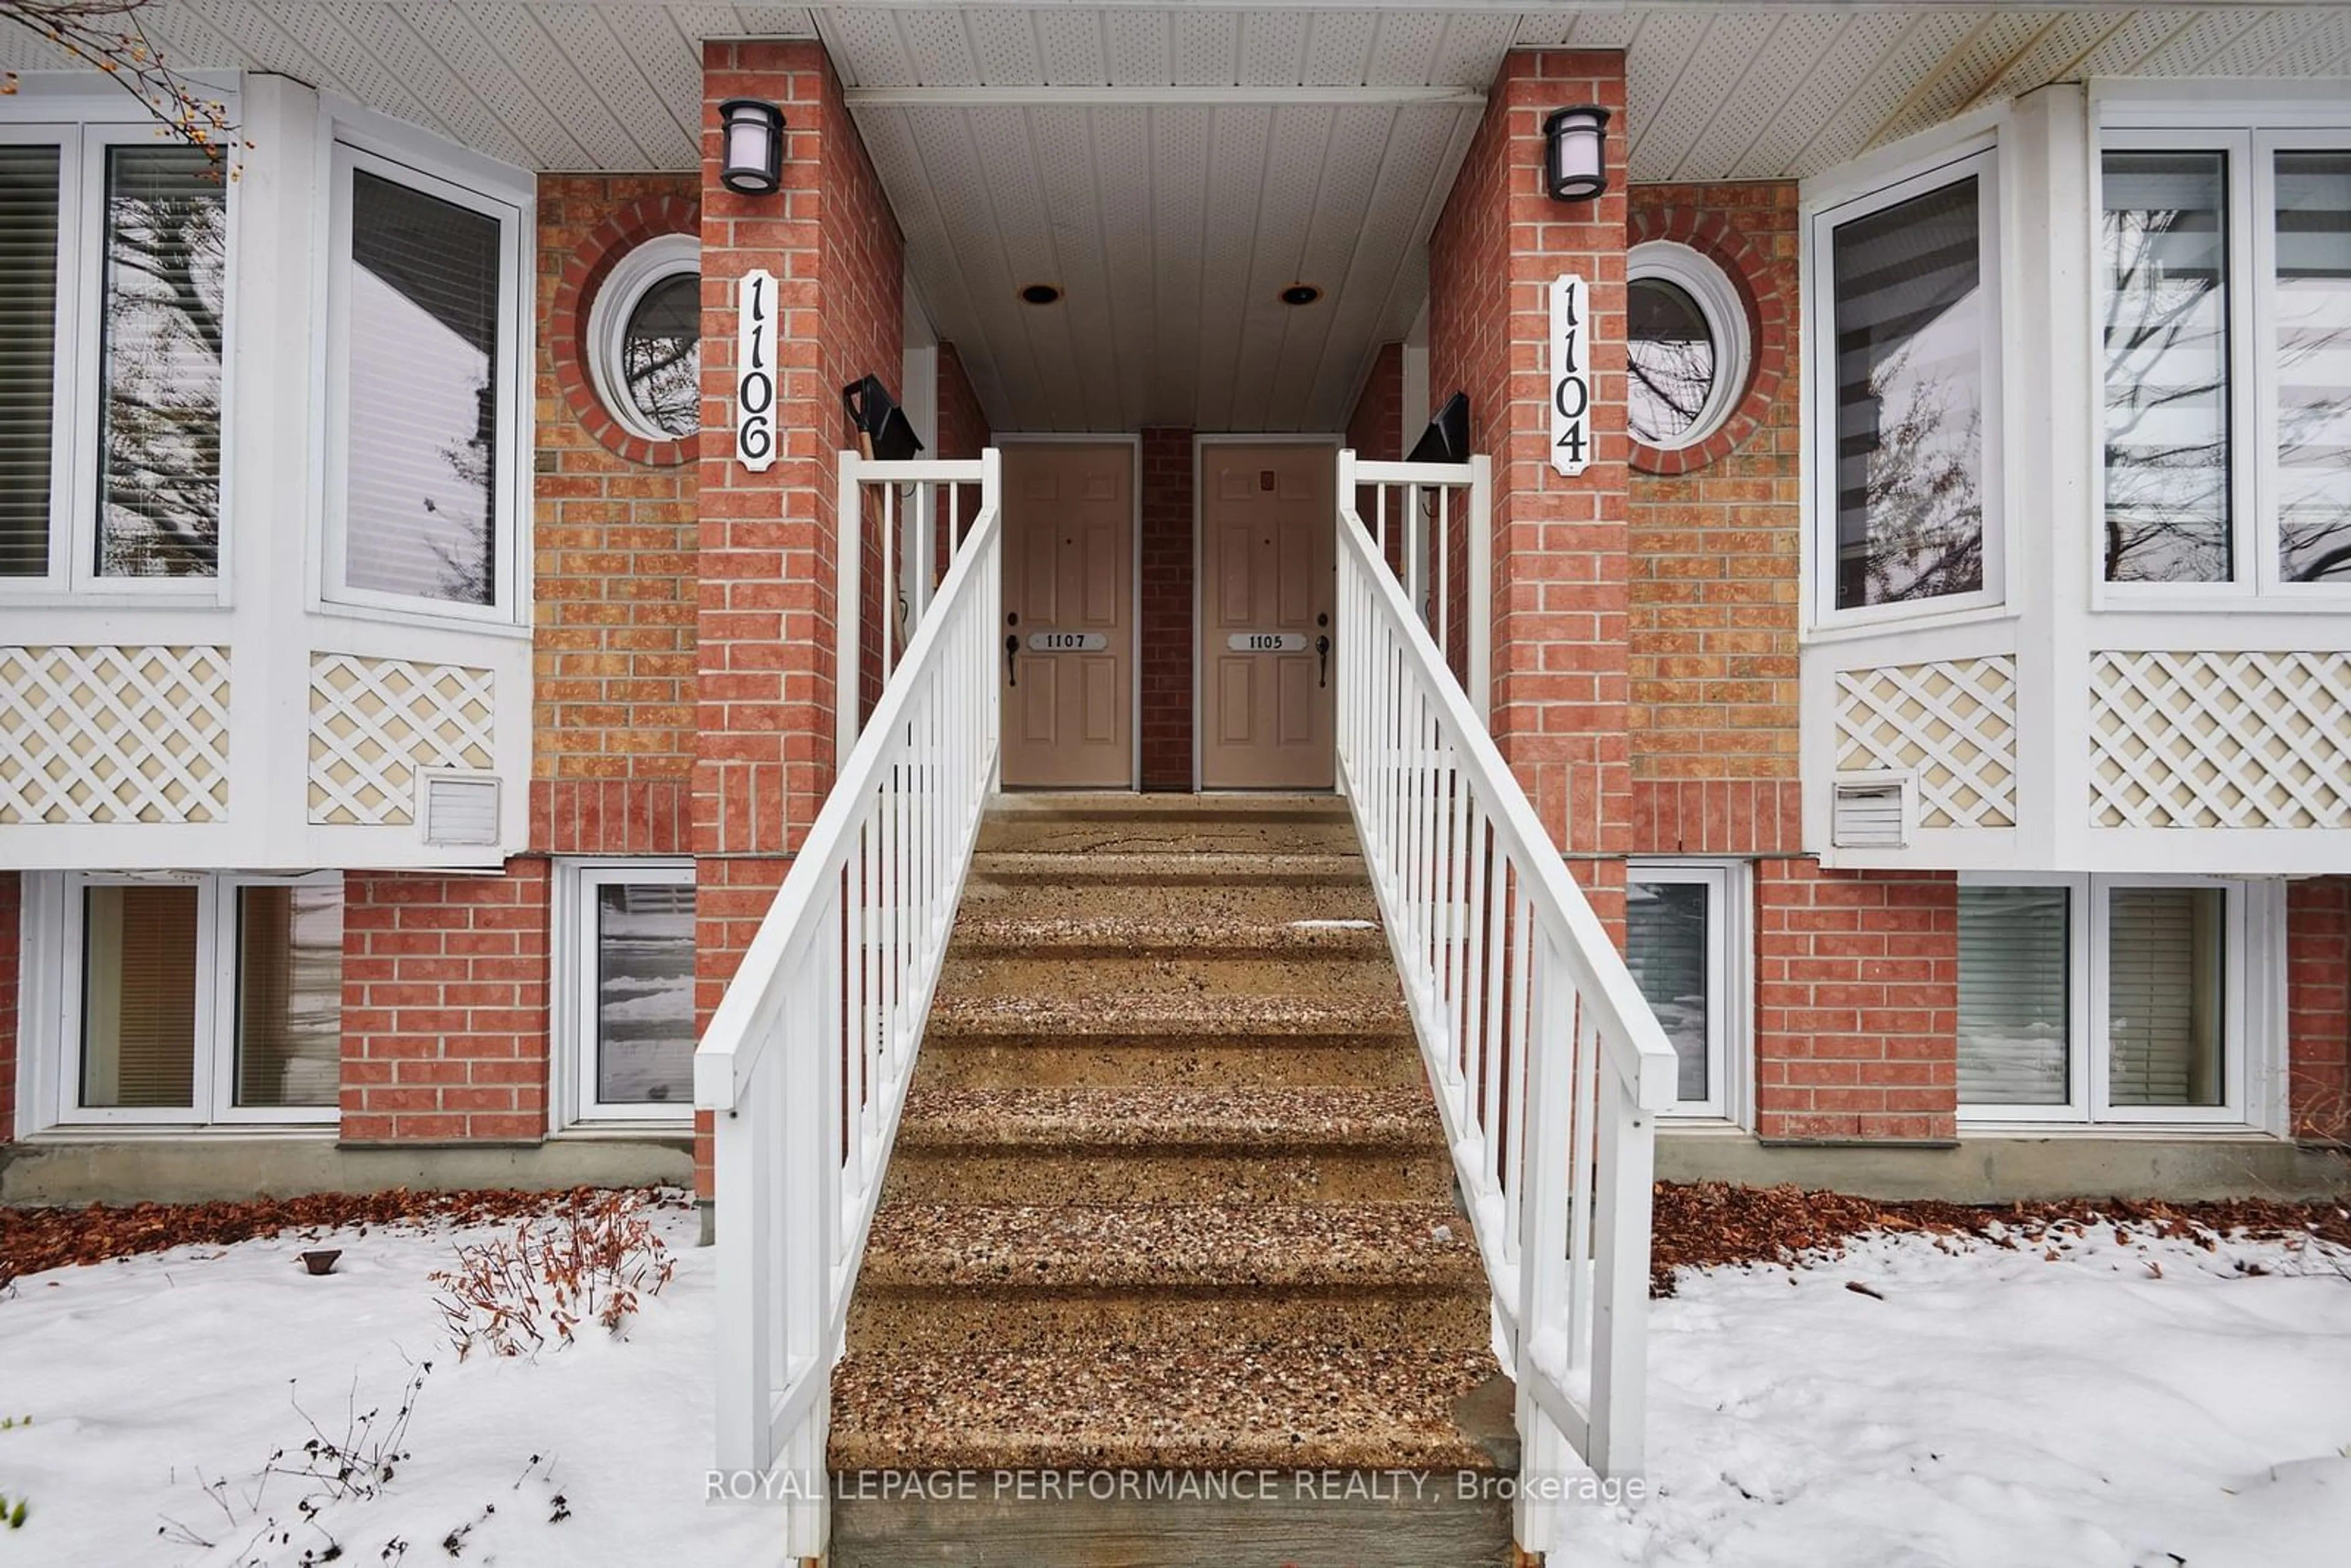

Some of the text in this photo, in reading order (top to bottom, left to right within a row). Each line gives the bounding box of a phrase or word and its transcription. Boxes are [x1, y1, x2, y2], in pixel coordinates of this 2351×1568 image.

[740, 277, 773, 459] 1106
[1556, 282, 1588, 462] 1104
[1047, 634, 1084, 647] 1107
[1250, 636, 1282, 648] 1105
